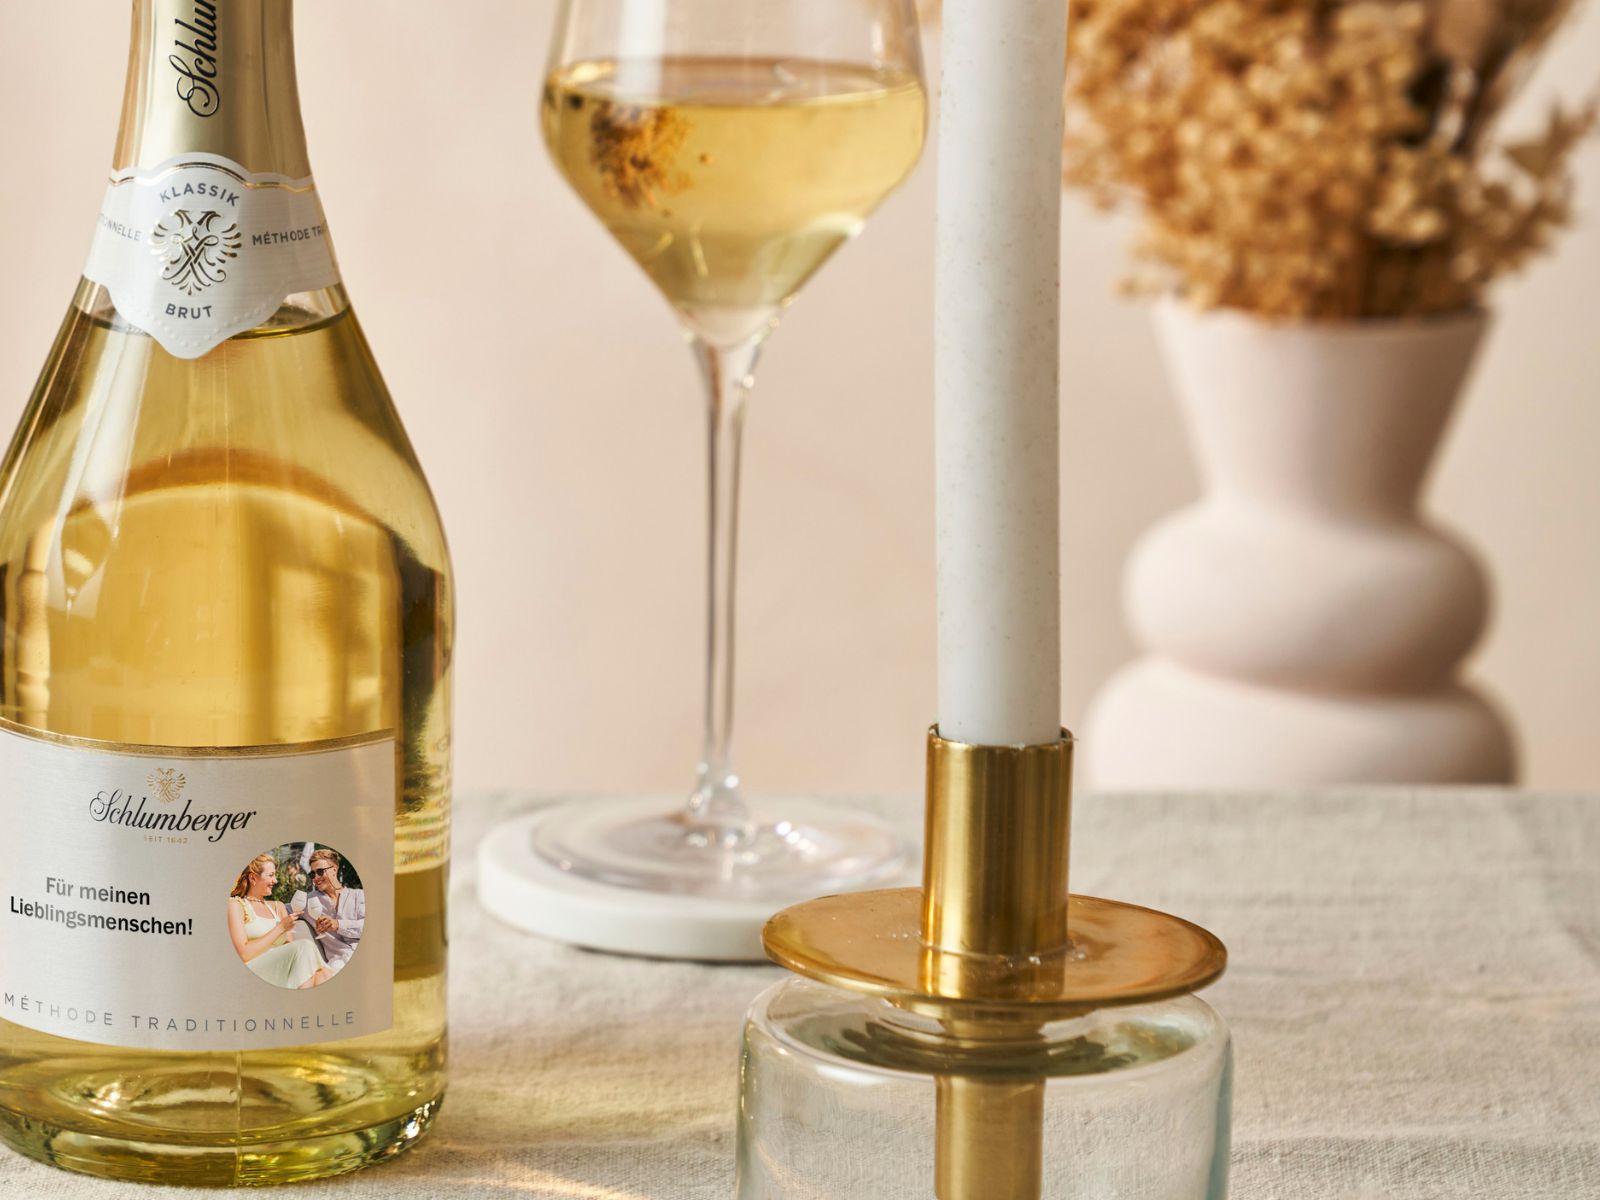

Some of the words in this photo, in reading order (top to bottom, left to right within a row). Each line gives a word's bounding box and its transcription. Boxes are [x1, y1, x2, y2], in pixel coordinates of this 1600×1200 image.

[159, 182, 240, 207] KLASSIK
[252, 228, 310, 246] MÉTHODE
[165, 303, 213, 320] BRUT
[89, 788, 256, 843] Schlumberger
[45, 876, 74, 897] Für
[79, 884, 151, 906] meinen
[9, 895, 194, 936] Lieblingsmenschen!
[3, 992, 114, 1027] MÉTHODE
[131, 1010, 356, 1033] TRADITIONNELLE
